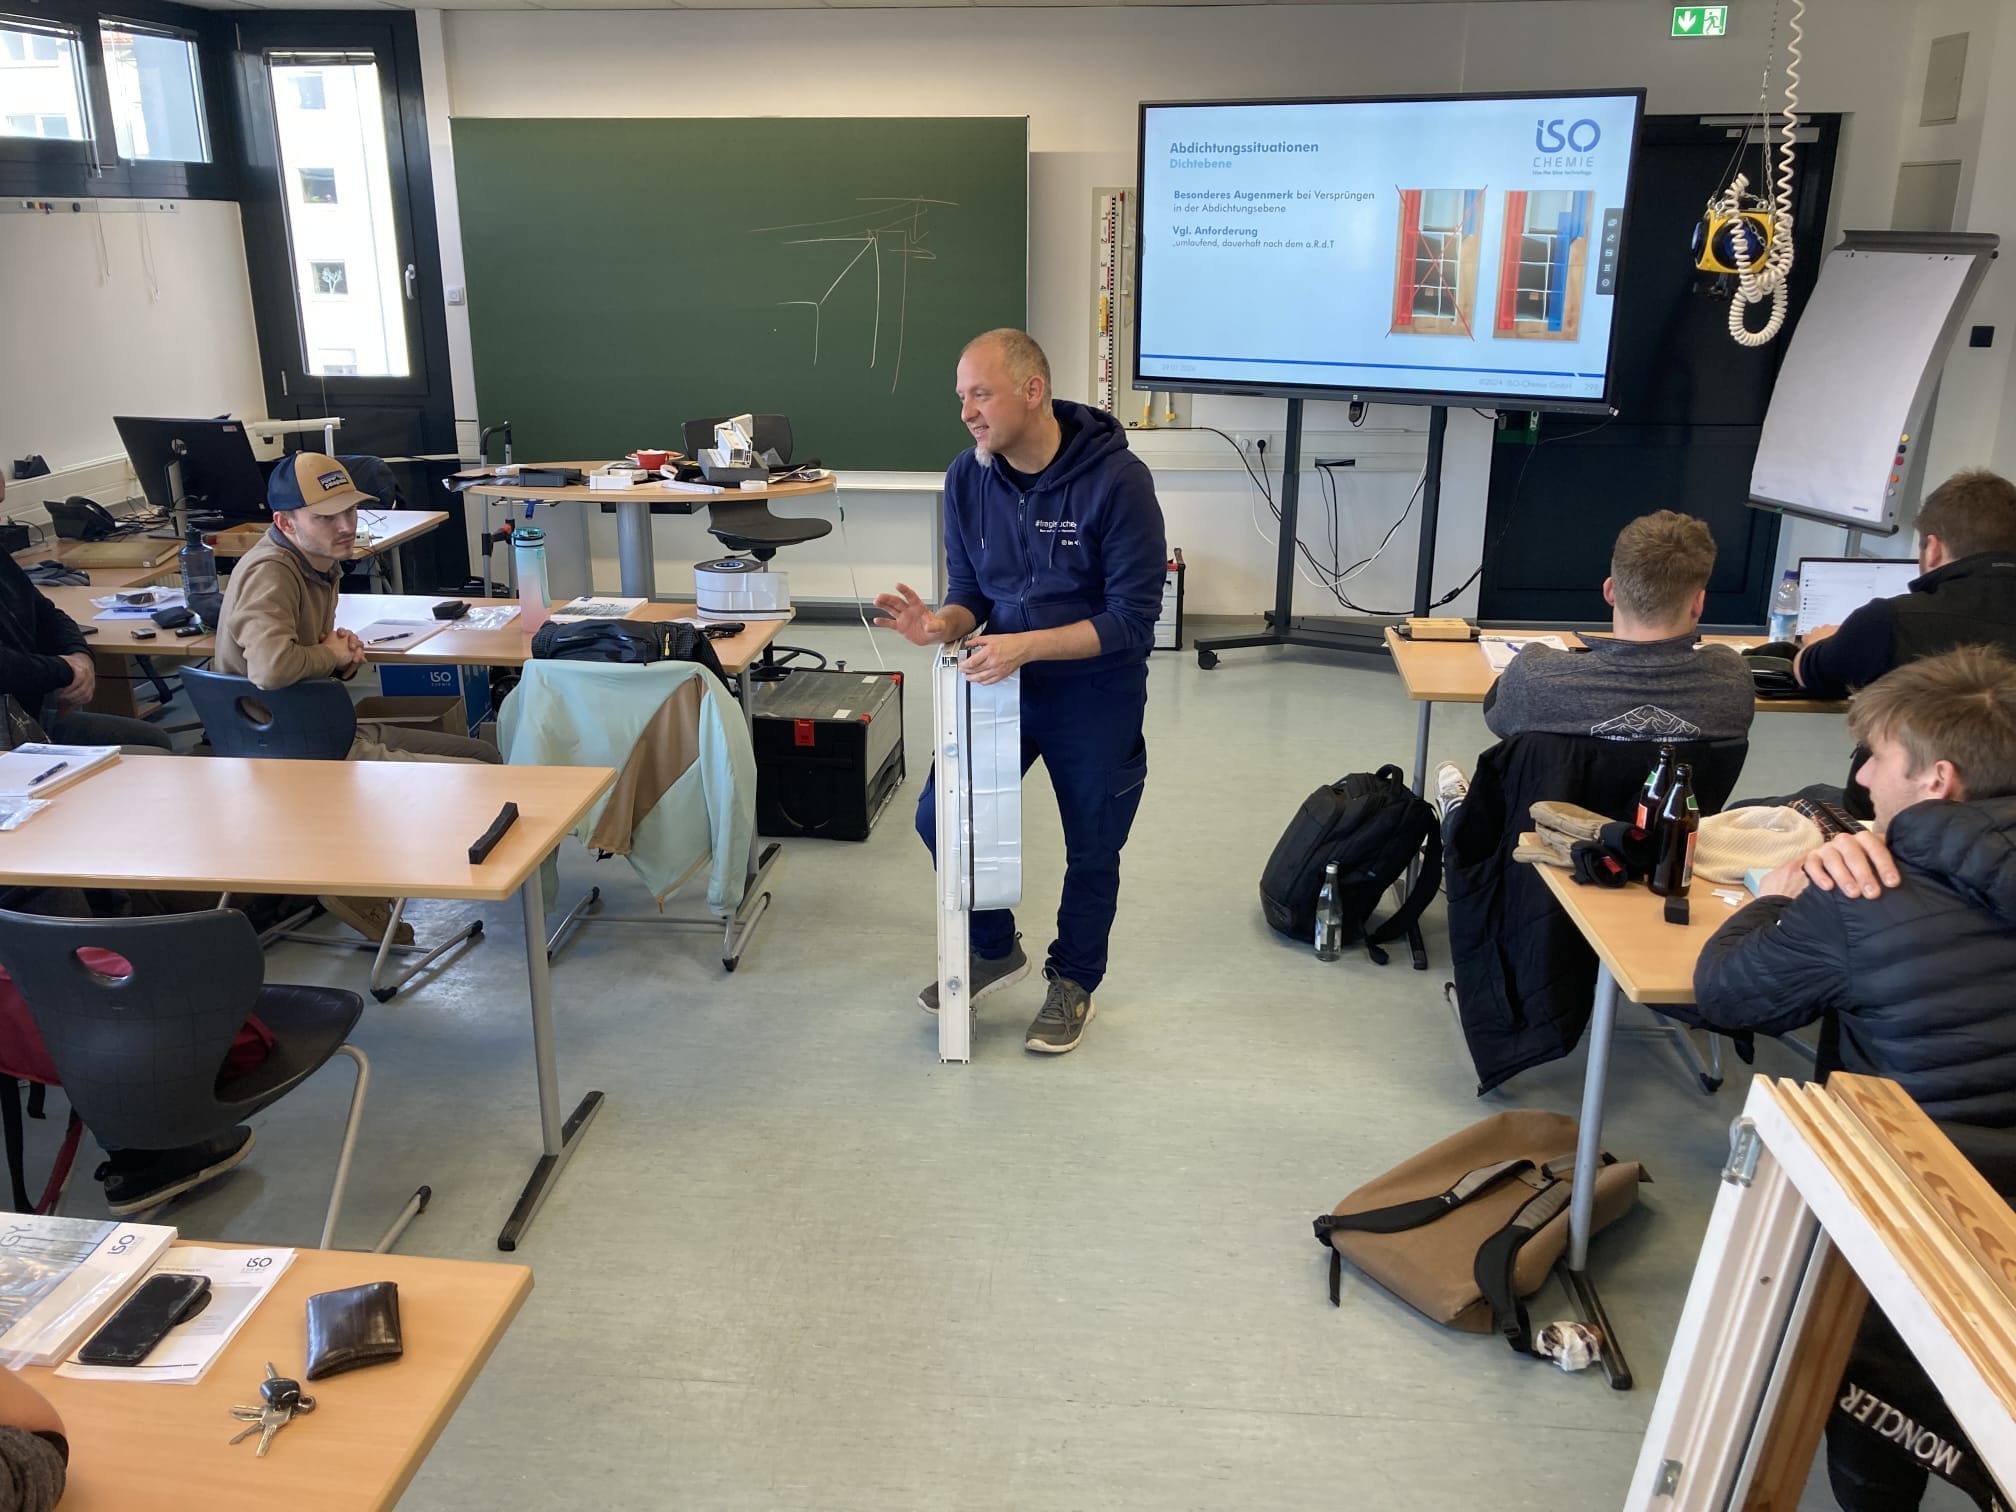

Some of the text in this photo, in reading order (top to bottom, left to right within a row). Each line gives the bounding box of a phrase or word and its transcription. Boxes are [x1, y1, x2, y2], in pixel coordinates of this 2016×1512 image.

[1170, 142, 1319, 155] Abdichtungssituationen
[1170, 158, 1232, 169] Dichtebene
[1533, 156, 1594, 168] CHEMIE
[1174, 189, 1375, 202] Besonderes Augenmerk bei Versprüngen
[1173, 203, 1286, 215] in der Abdichtungsebene
[1172, 225, 1258, 238] Vgl. Anforderung
[1222, 239, 1261, 248] dauerhaft
[1263, 239, 1283, 249] nach
[1285, 240, 1303, 248] dem
[1840, 1382, 1962, 1475] MONCLER
